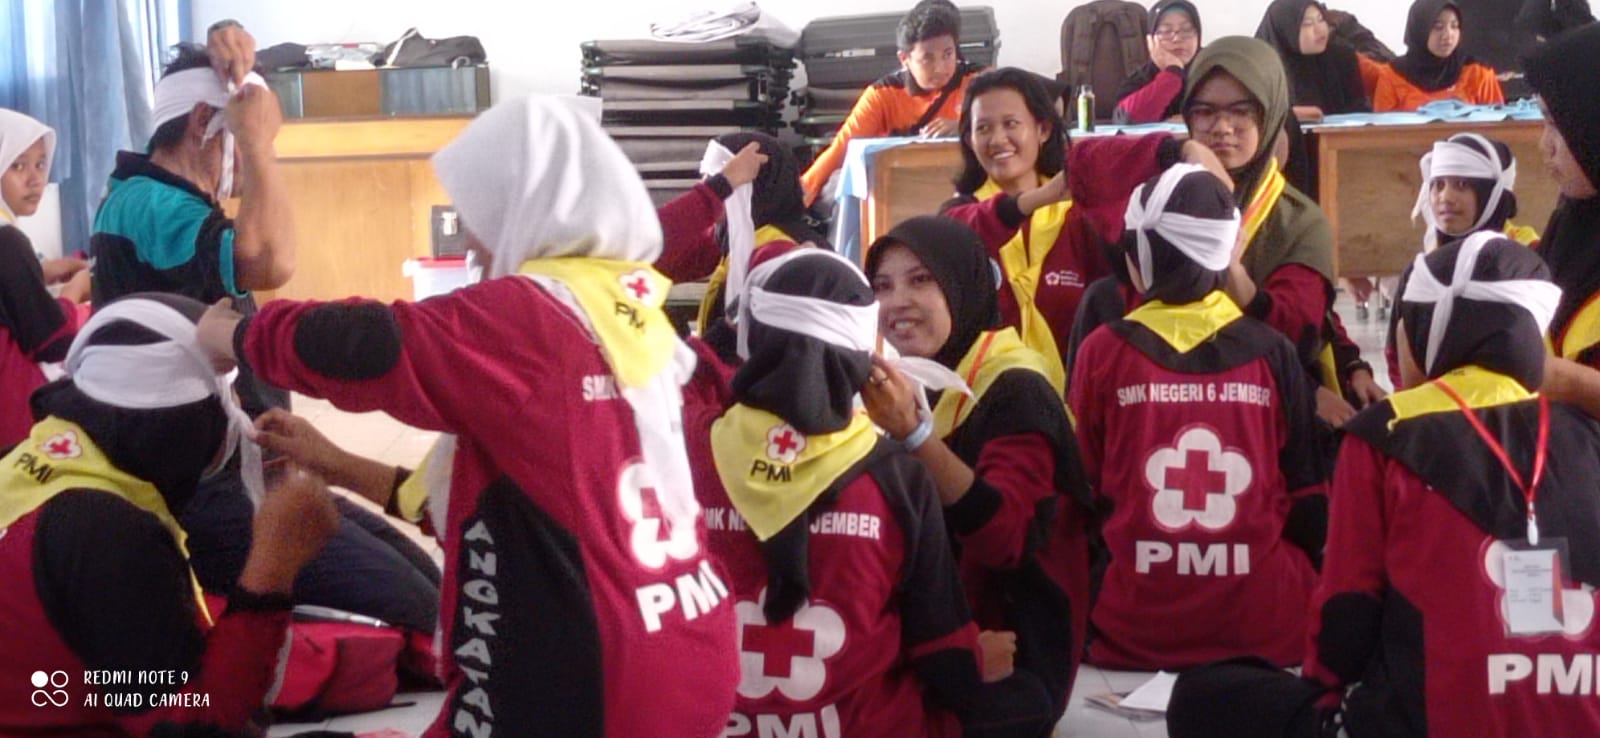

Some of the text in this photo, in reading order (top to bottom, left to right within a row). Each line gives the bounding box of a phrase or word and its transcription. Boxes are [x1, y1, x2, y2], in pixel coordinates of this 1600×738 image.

[1117, 382, 1270, 407] SMK NEGERI 6 JEMBER
[13, 451, 54, 484] PMI
[750, 459, 792, 483] PMI
[704, 507, 725, 530] MK
[810, 511, 881, 539] JEMBER
[1135, 540, 1251, 577] PMI
[635, 559, 729, 633] PMI
[1487, 653, 1600, 696] PM
